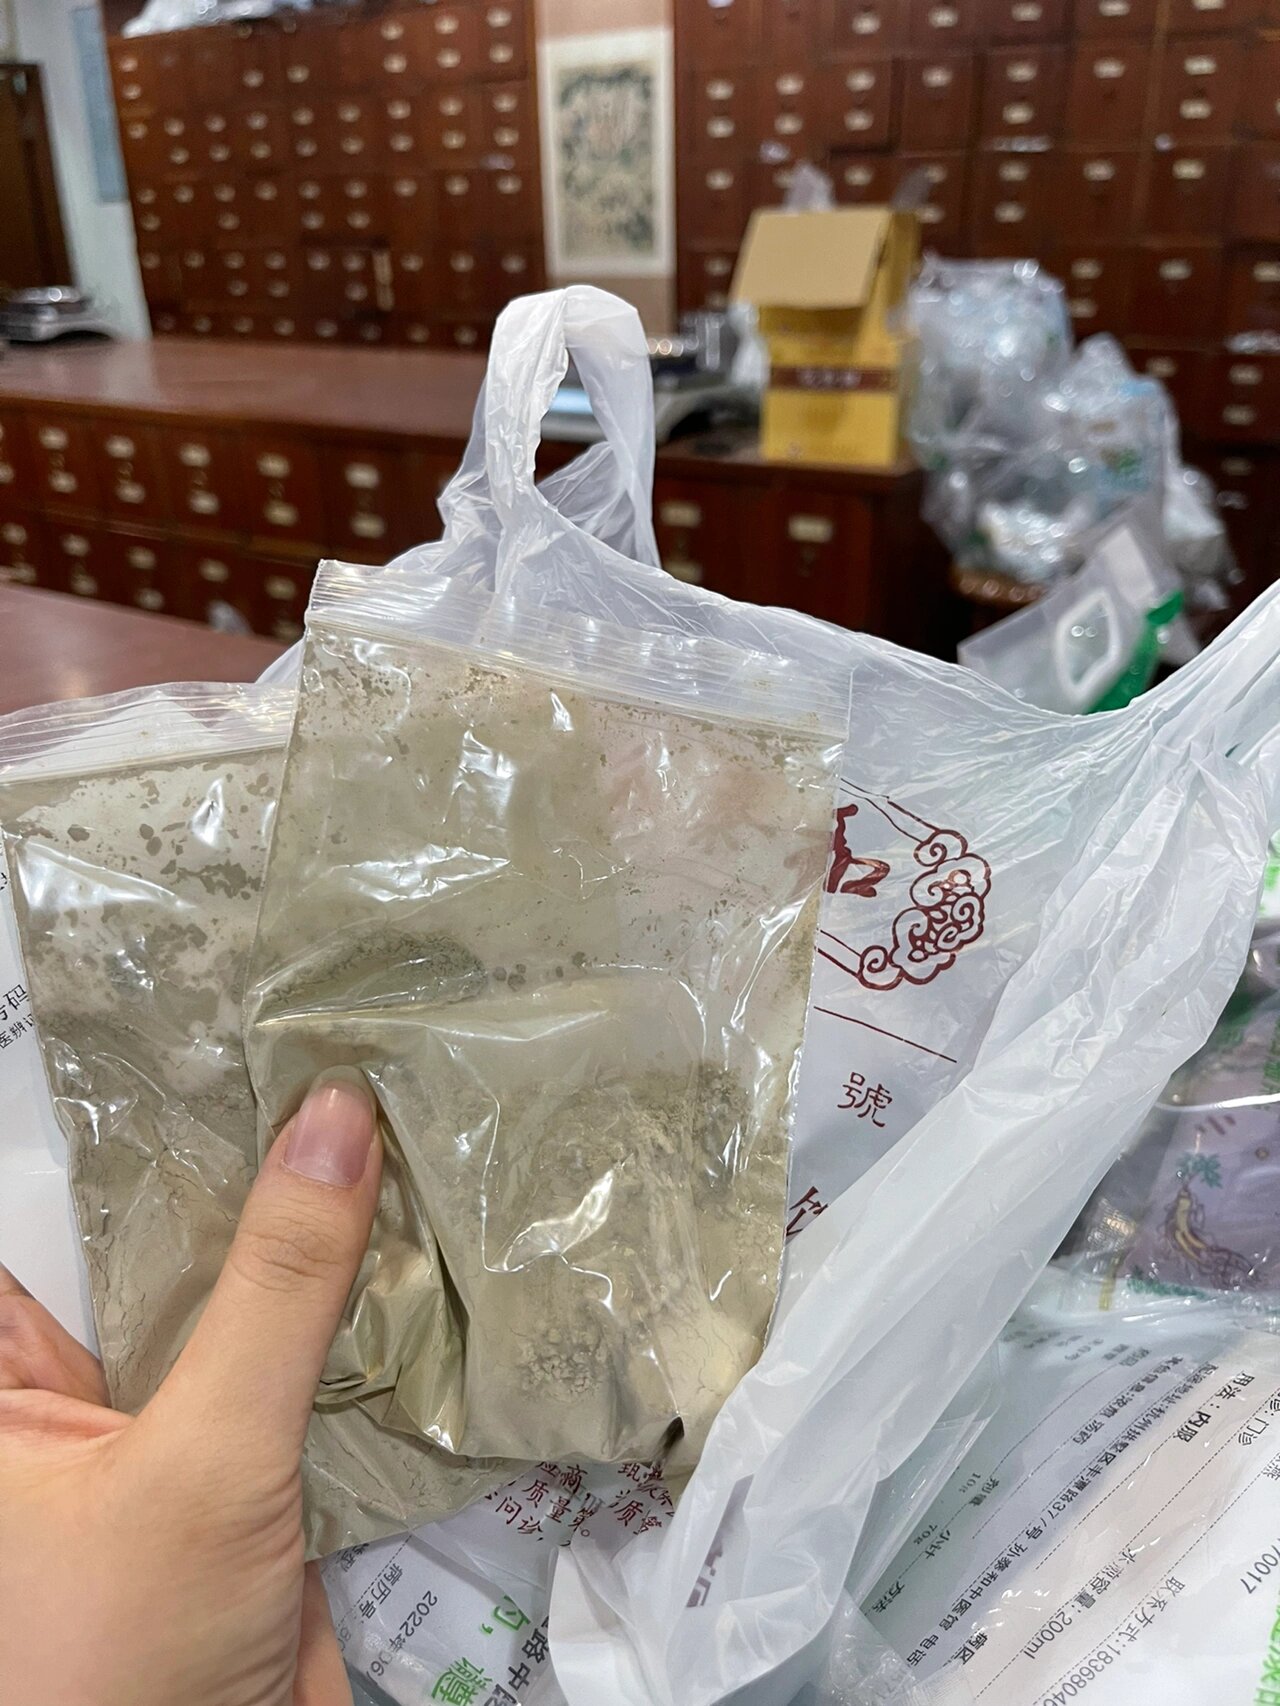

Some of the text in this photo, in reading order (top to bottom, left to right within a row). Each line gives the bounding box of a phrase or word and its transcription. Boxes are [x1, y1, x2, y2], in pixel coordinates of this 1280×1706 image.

[837, 1072, 893, 1128] 號
[920, 1529, 951, 1560] 小计
[872, 1580, 905, 1613] 方法
[903, 1634, 939, 1667] 电话
[953, 1633, 988, 1666] 病区
[1020, 1611, 1073, 1660] 200ml
